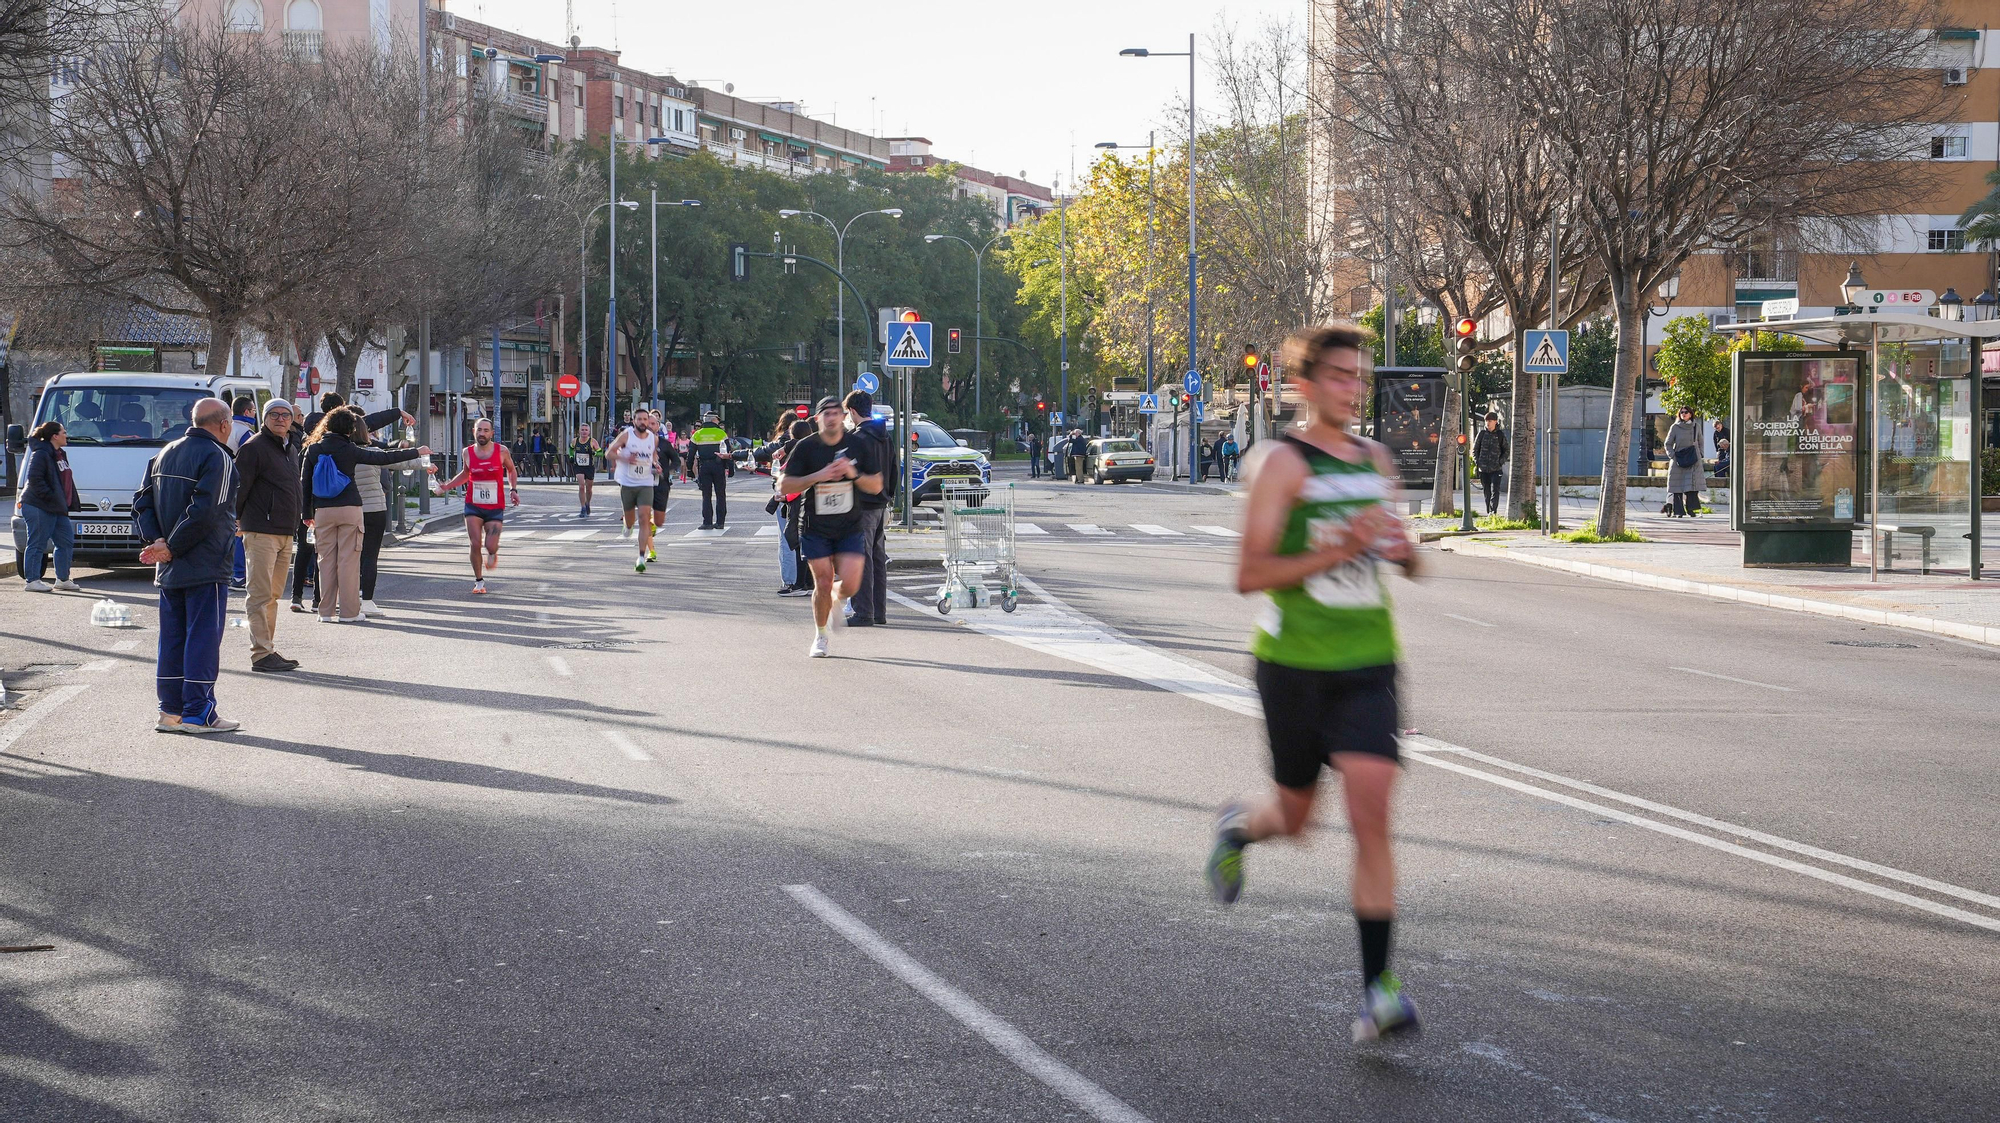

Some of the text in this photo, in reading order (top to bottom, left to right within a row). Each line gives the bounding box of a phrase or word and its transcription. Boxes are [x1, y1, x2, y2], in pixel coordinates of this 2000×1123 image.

[1903, 293, 1909, 301] E
[1786, 414, 1799, 422] LA
[1753, 422, 1799, 430] SOCIEDAD
[1763, 428, 1819, 437] AVANZA Y LA
[1799, 435, 1853, 443] PUBLICIDAD
[1799, 442, 1843, 450] CON ELLA
[634, 466, 644, 475] 40
[480, 490, 490, 500] 66
[1837, 488, 1850, 497] 30
[84, 525, 130, 534] 3232 CRZ
